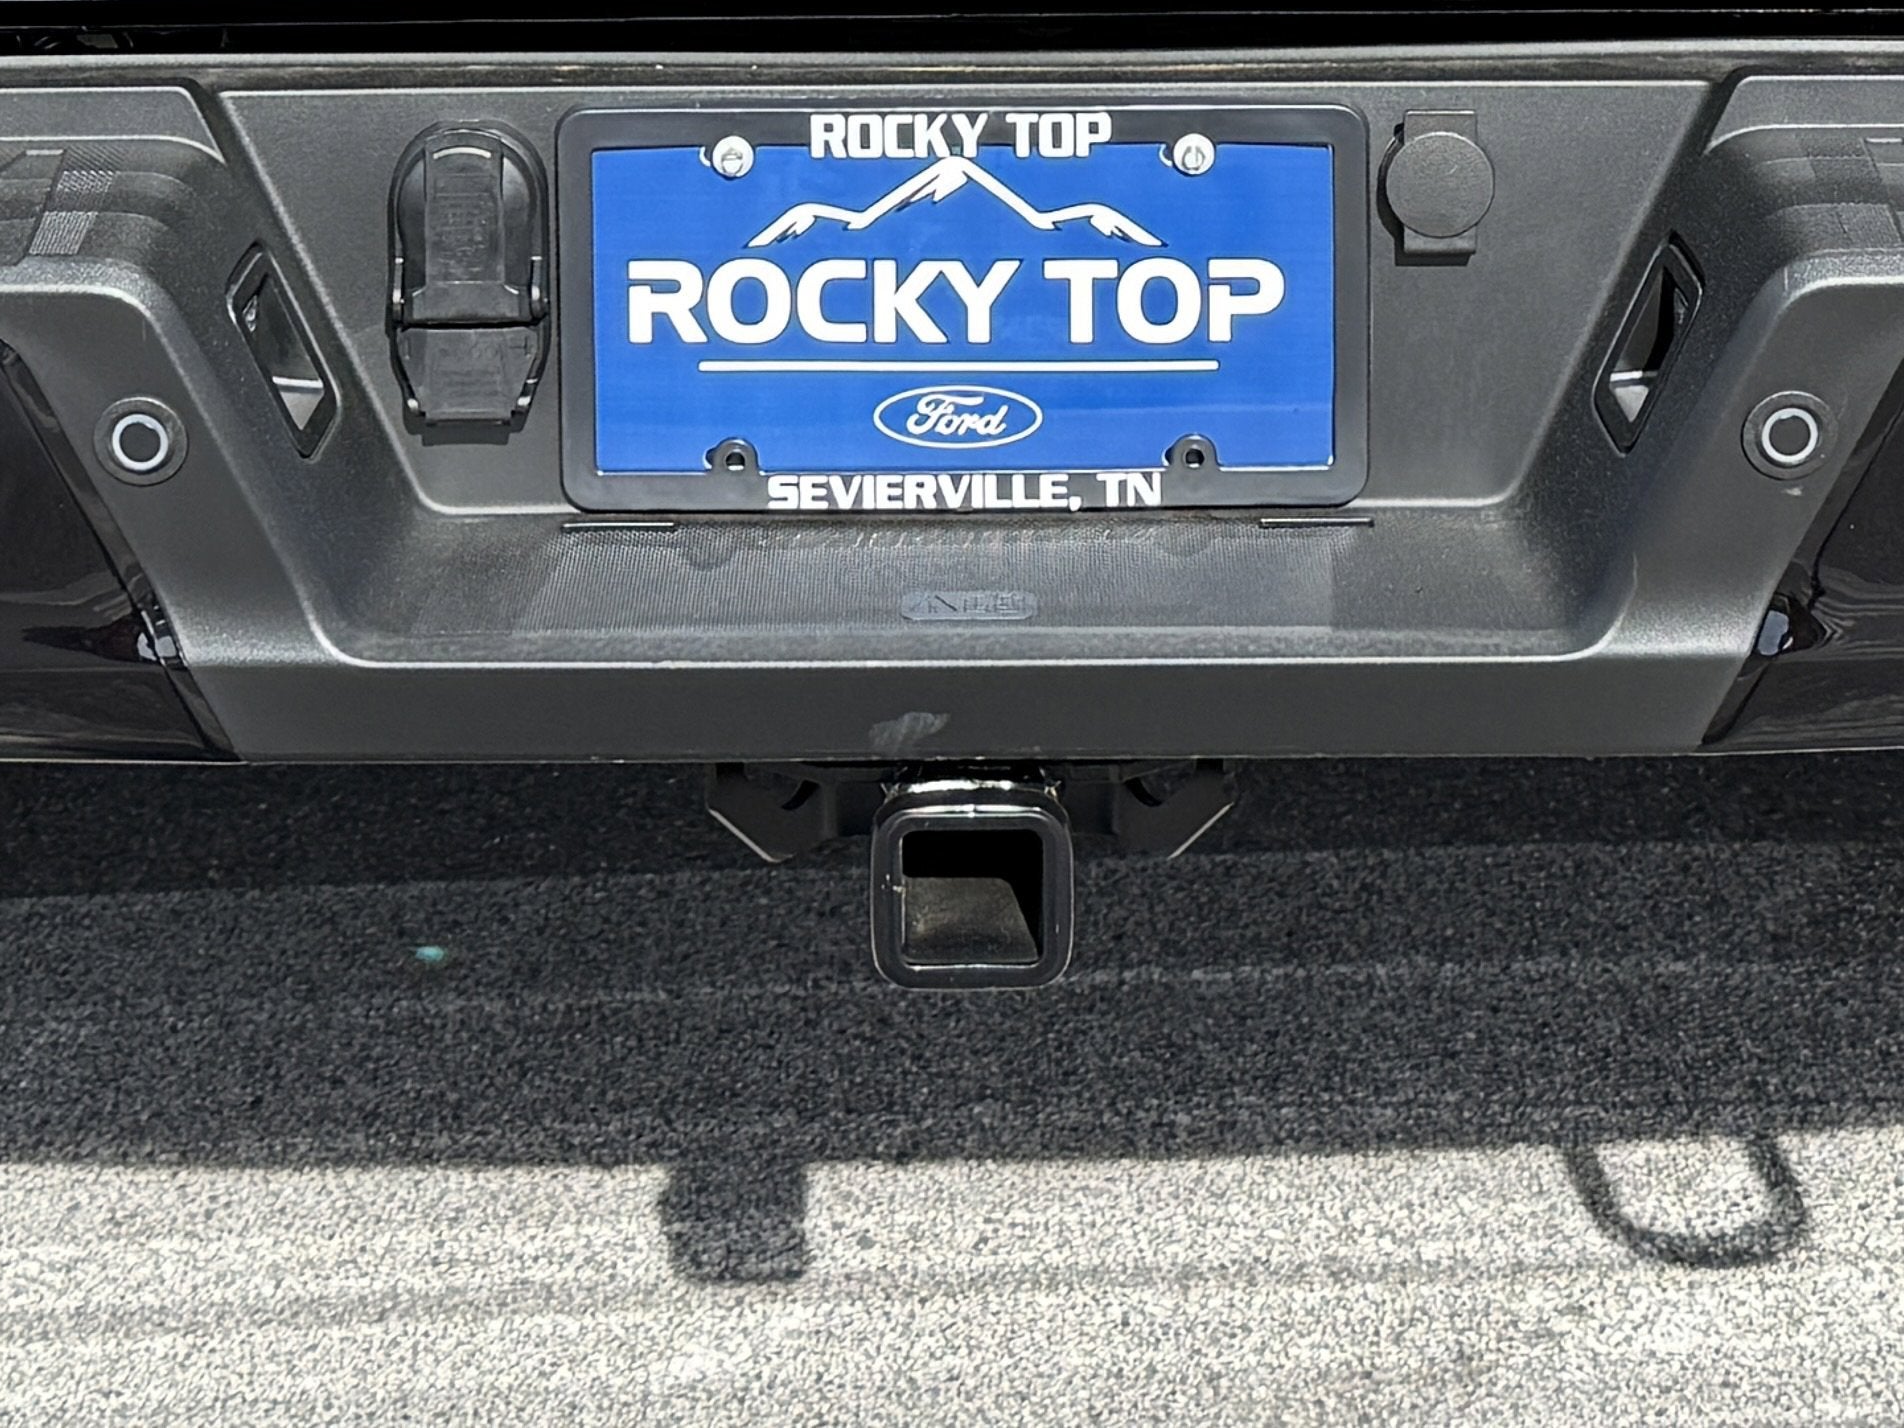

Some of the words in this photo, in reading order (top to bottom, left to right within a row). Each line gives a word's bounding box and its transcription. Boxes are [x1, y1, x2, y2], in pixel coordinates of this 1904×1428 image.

[810, 112, 986, 158] ROCKY
[1006, 112, 1113, 158] TOP
[627, 258, 1022, 345] ROCKY
[1043, 259, 1286, 345] TOP
[906, 393, 1009, 436] Ford
[767, 474, 1082, 513] SEVIERVILLE,
[1097, 472, 1162, 508] TN
